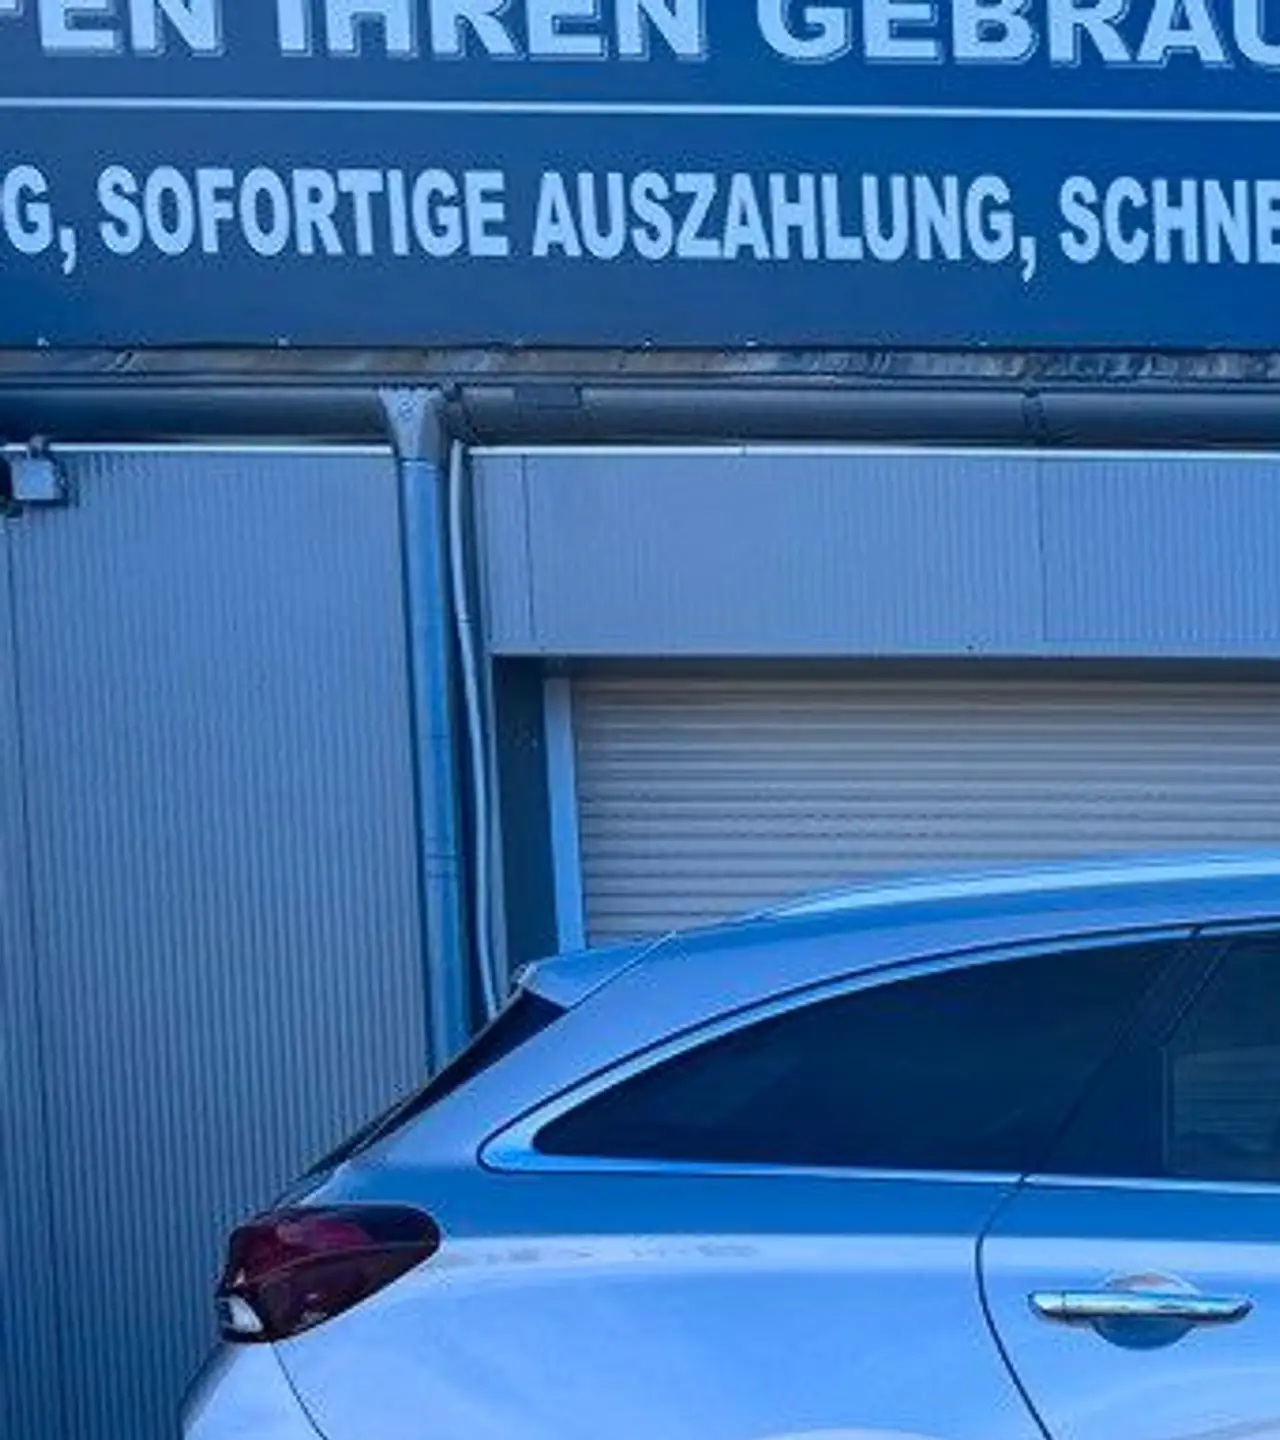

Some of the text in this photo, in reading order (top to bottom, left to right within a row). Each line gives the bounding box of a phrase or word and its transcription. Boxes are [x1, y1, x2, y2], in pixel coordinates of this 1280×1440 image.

[277, 0, 709, 61] IHREN
[97, 165, 509, 257] SOFORTIGE
[532, 171, 1037, 283] AUSZAHLUNG,
